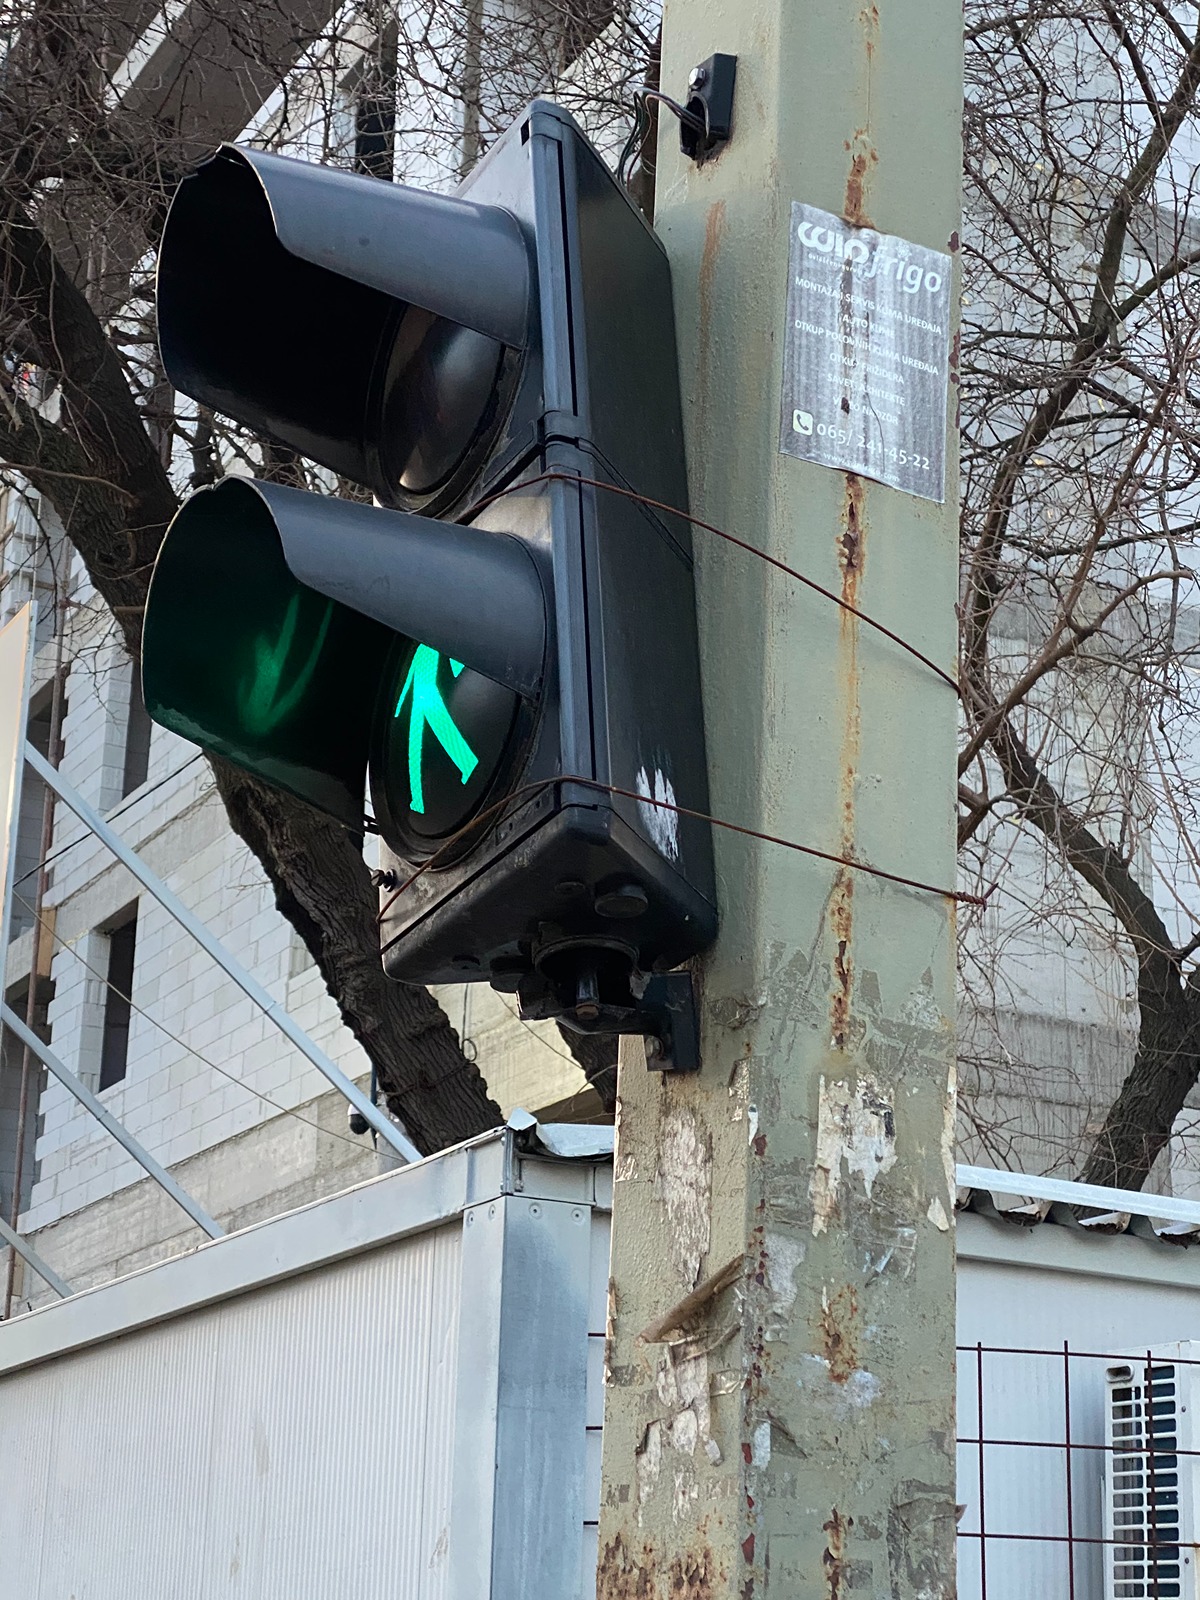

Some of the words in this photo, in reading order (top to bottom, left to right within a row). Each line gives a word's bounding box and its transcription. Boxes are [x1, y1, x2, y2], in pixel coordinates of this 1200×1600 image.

[795, 276, 838, 298] MONTAŽA
[845, 292, 874, 310] SERVIS
[904, 313, 941, 334] UREĐAJA
[794, 319, 823, 337] OTKUP
[902, 354, 938, 375] UREĐAJA
[816, 423, 852, 447] 065/
[856, 435, 930, 470] 241-45-22
